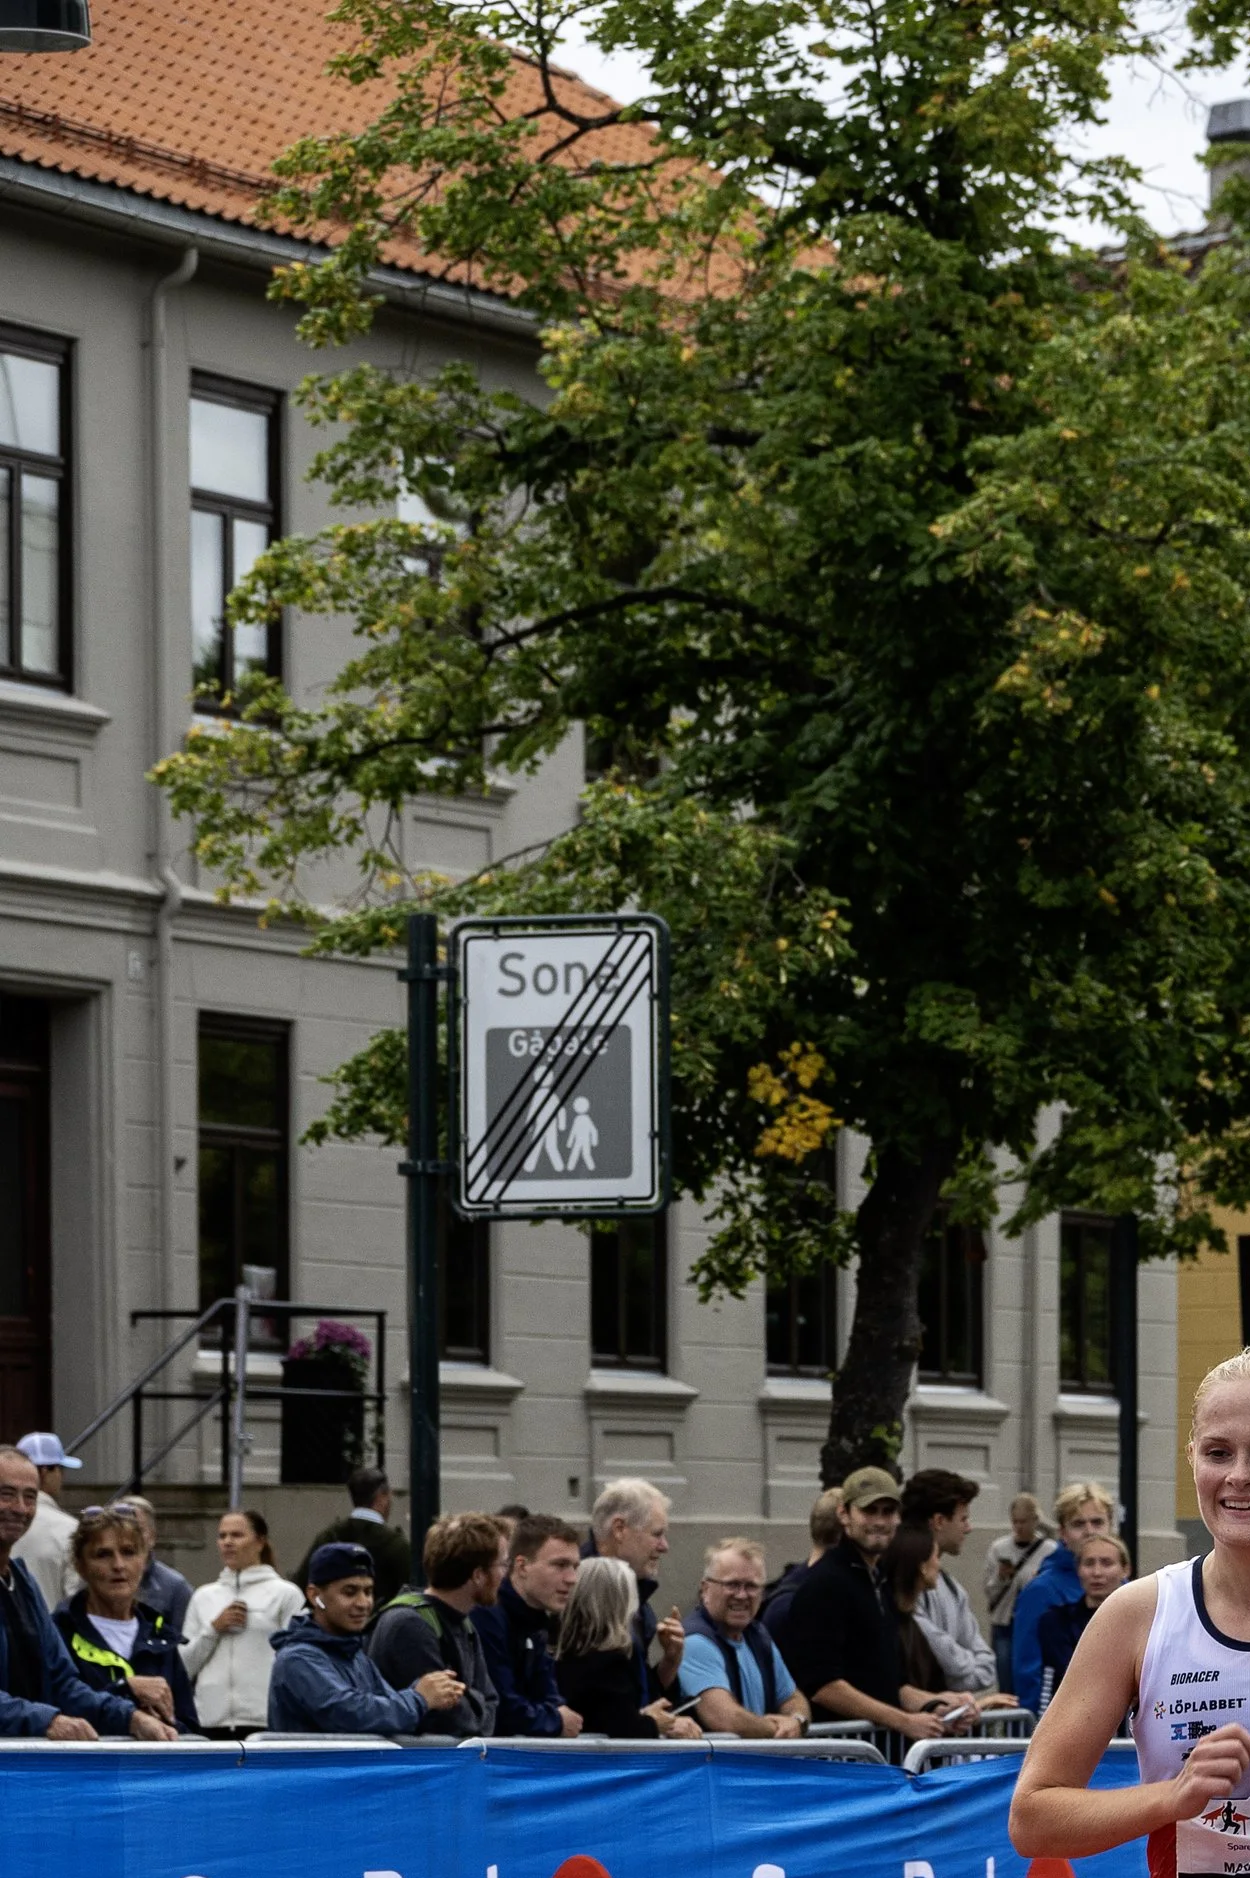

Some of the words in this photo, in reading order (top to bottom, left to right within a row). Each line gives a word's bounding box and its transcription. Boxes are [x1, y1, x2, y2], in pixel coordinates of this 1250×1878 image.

[497, 952, 619, 997] Sone
[1170, 1670, 1220, 1686] BIORACER
[1169, 1697, 1245, 1715] LÖPLABBET
